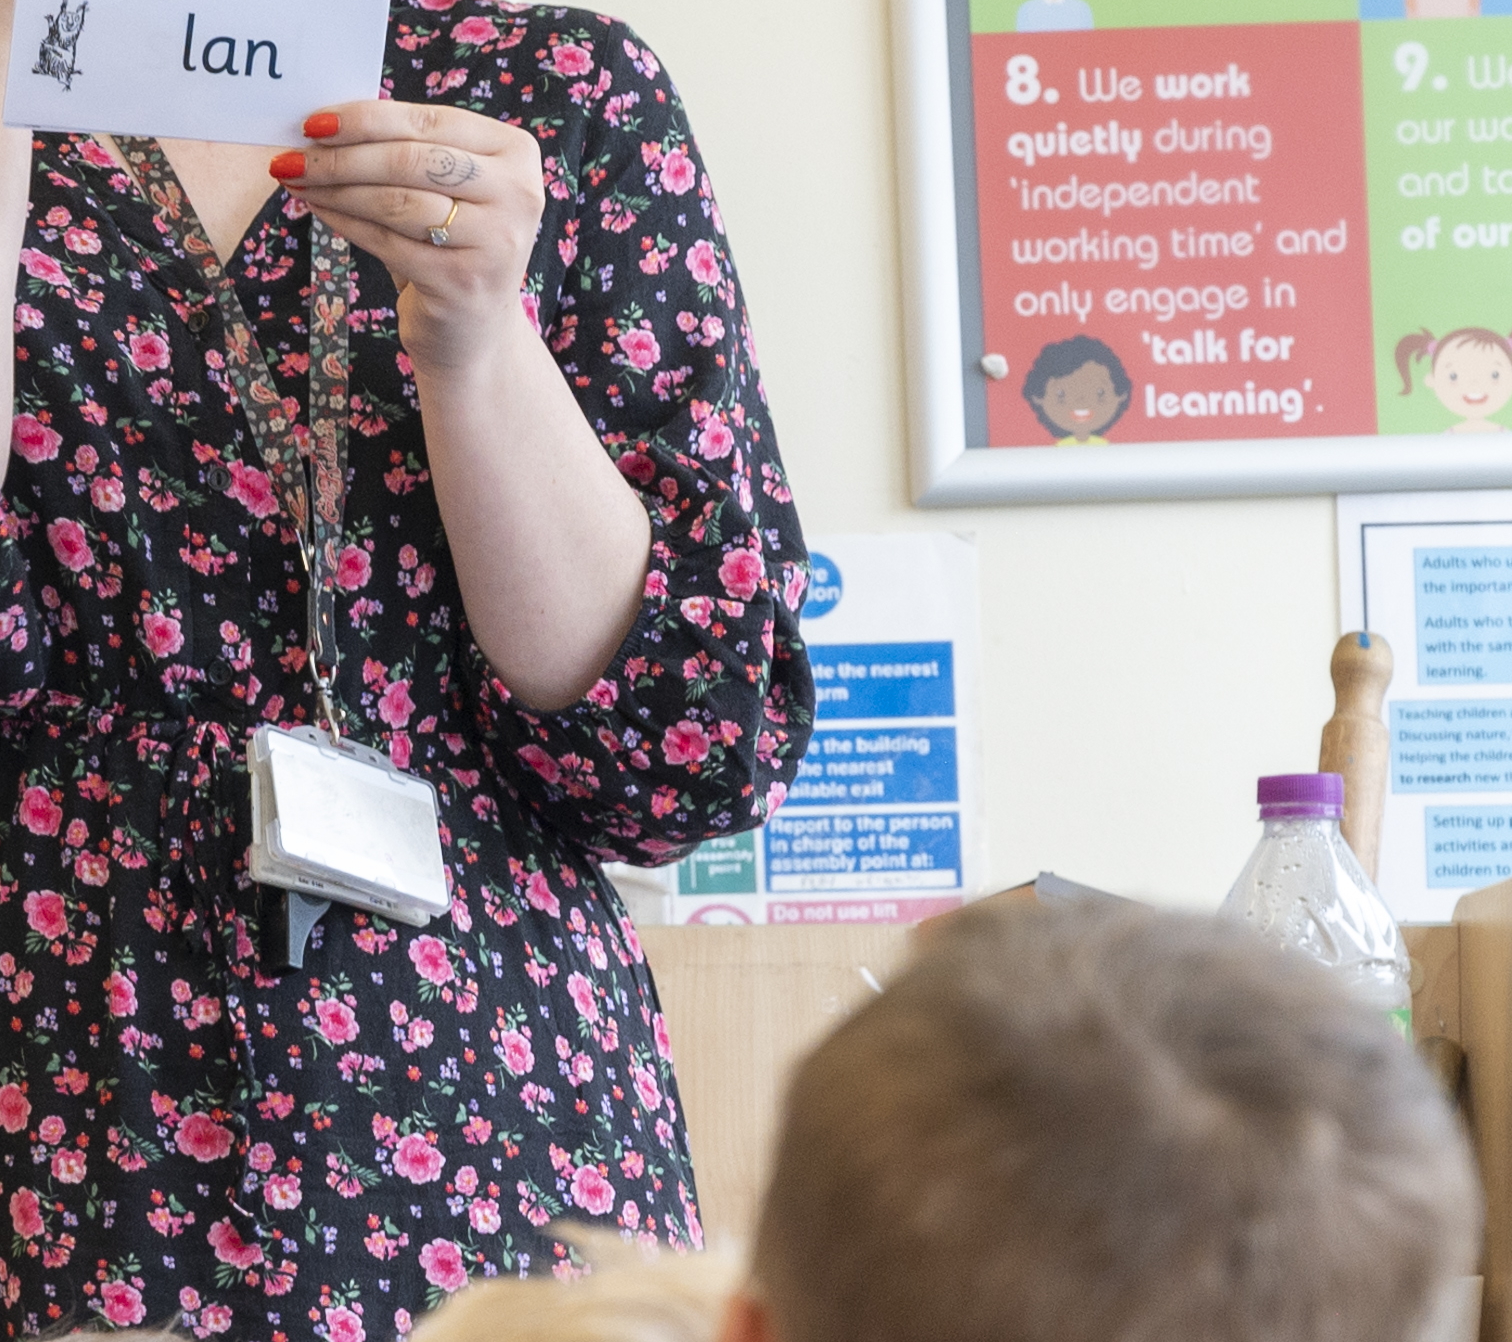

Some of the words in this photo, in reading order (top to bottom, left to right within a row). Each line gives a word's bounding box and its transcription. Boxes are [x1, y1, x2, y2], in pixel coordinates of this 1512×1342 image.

[182, 12, 283, 80] lan
[870, 661, 939, 680] nearest
[855, 735, 931, 757] building
[826, 758, 895, 777] nearest
[769, 816, 831, 836] Report
[834, 817, 854, 834] to
[855, 816, 886, 833] the
[887, 815, 954, 836] person
[1432, 814, 1483, 830] Setting
[1486, 816, 1505, 828] up
[769, 837, 788, 854] in
[791, 836, 853, 857] charge
[856, 834, 877, 851] of
[879, 833, 911, 851] the
[1433, 839, 1497, 853] activities
[770, 855, 856, 874] assembly
[860, 854, 907, 871] point
